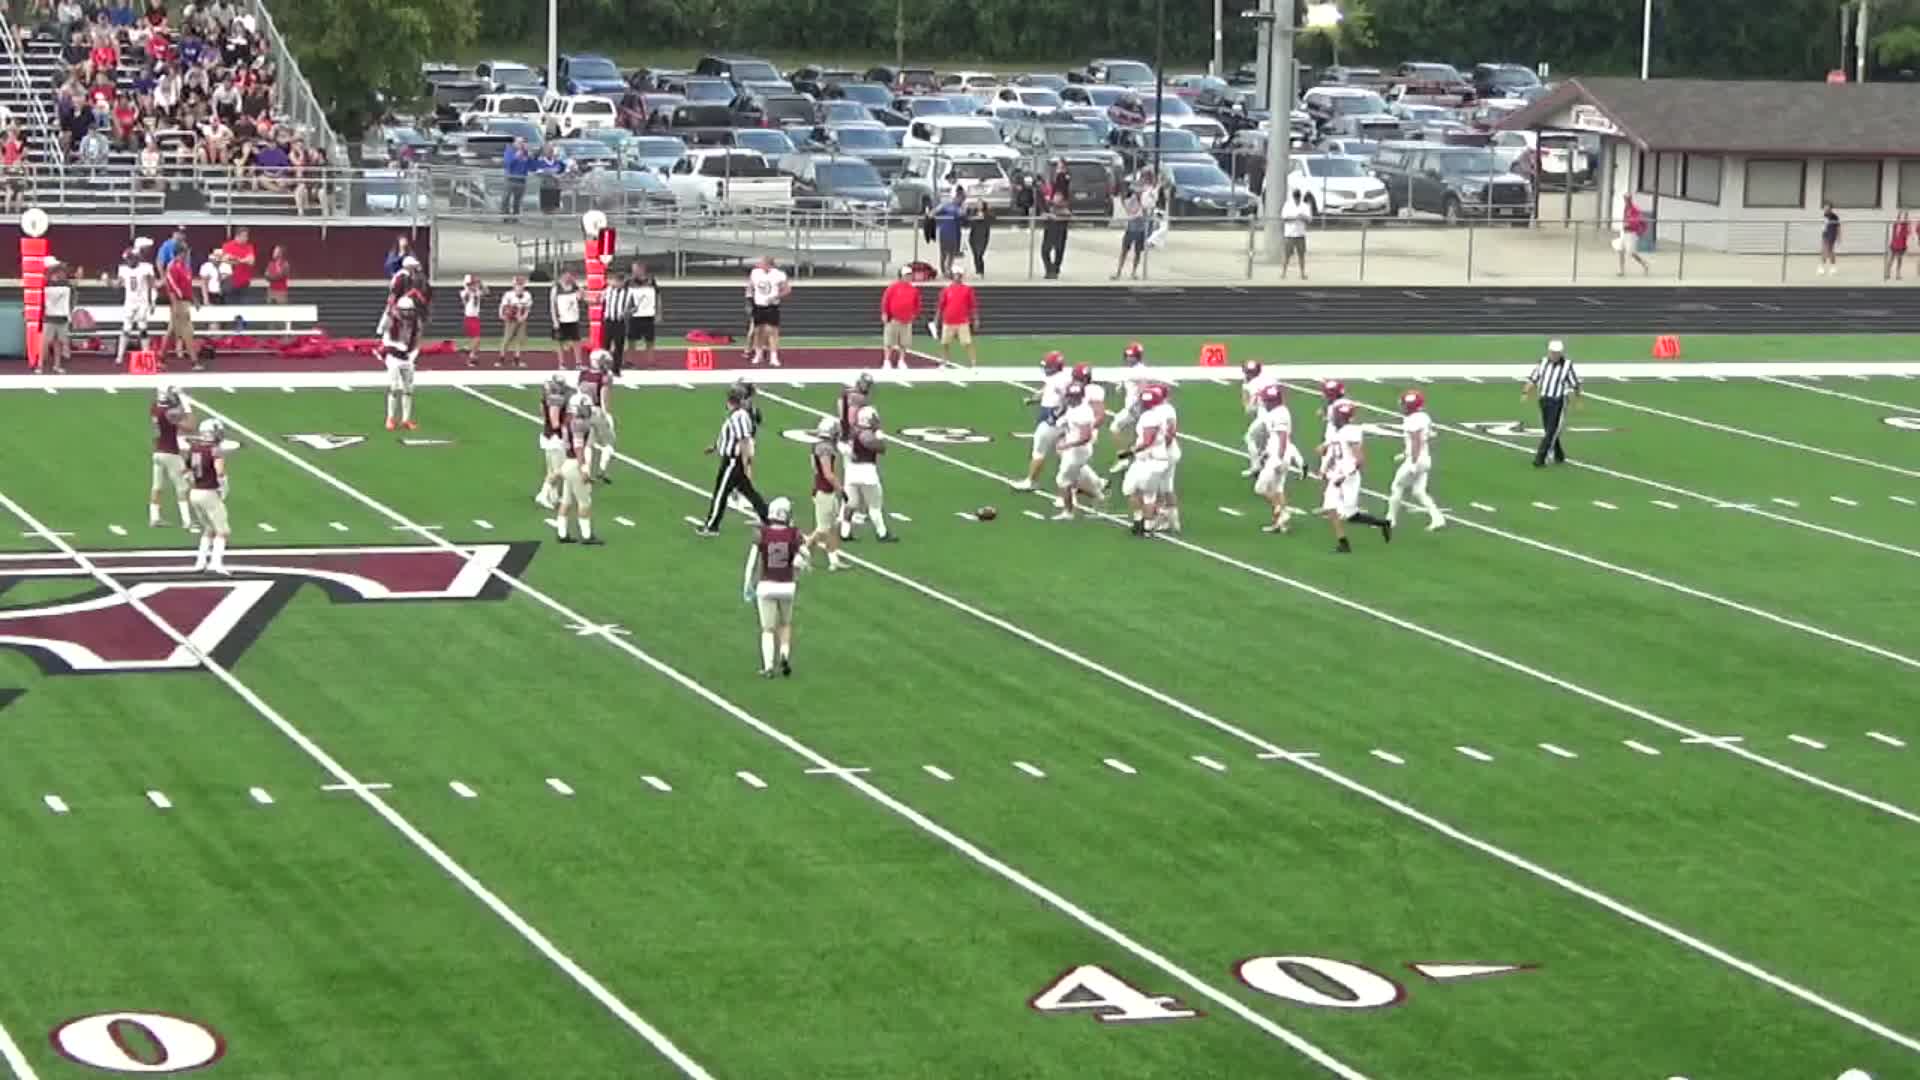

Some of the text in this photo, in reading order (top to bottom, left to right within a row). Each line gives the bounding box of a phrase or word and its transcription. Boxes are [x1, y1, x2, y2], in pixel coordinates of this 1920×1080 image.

[135, 351, 154, 369] 40
[1206, 348, 1224, 363] 20
[767, 542, 790, 568] 12
